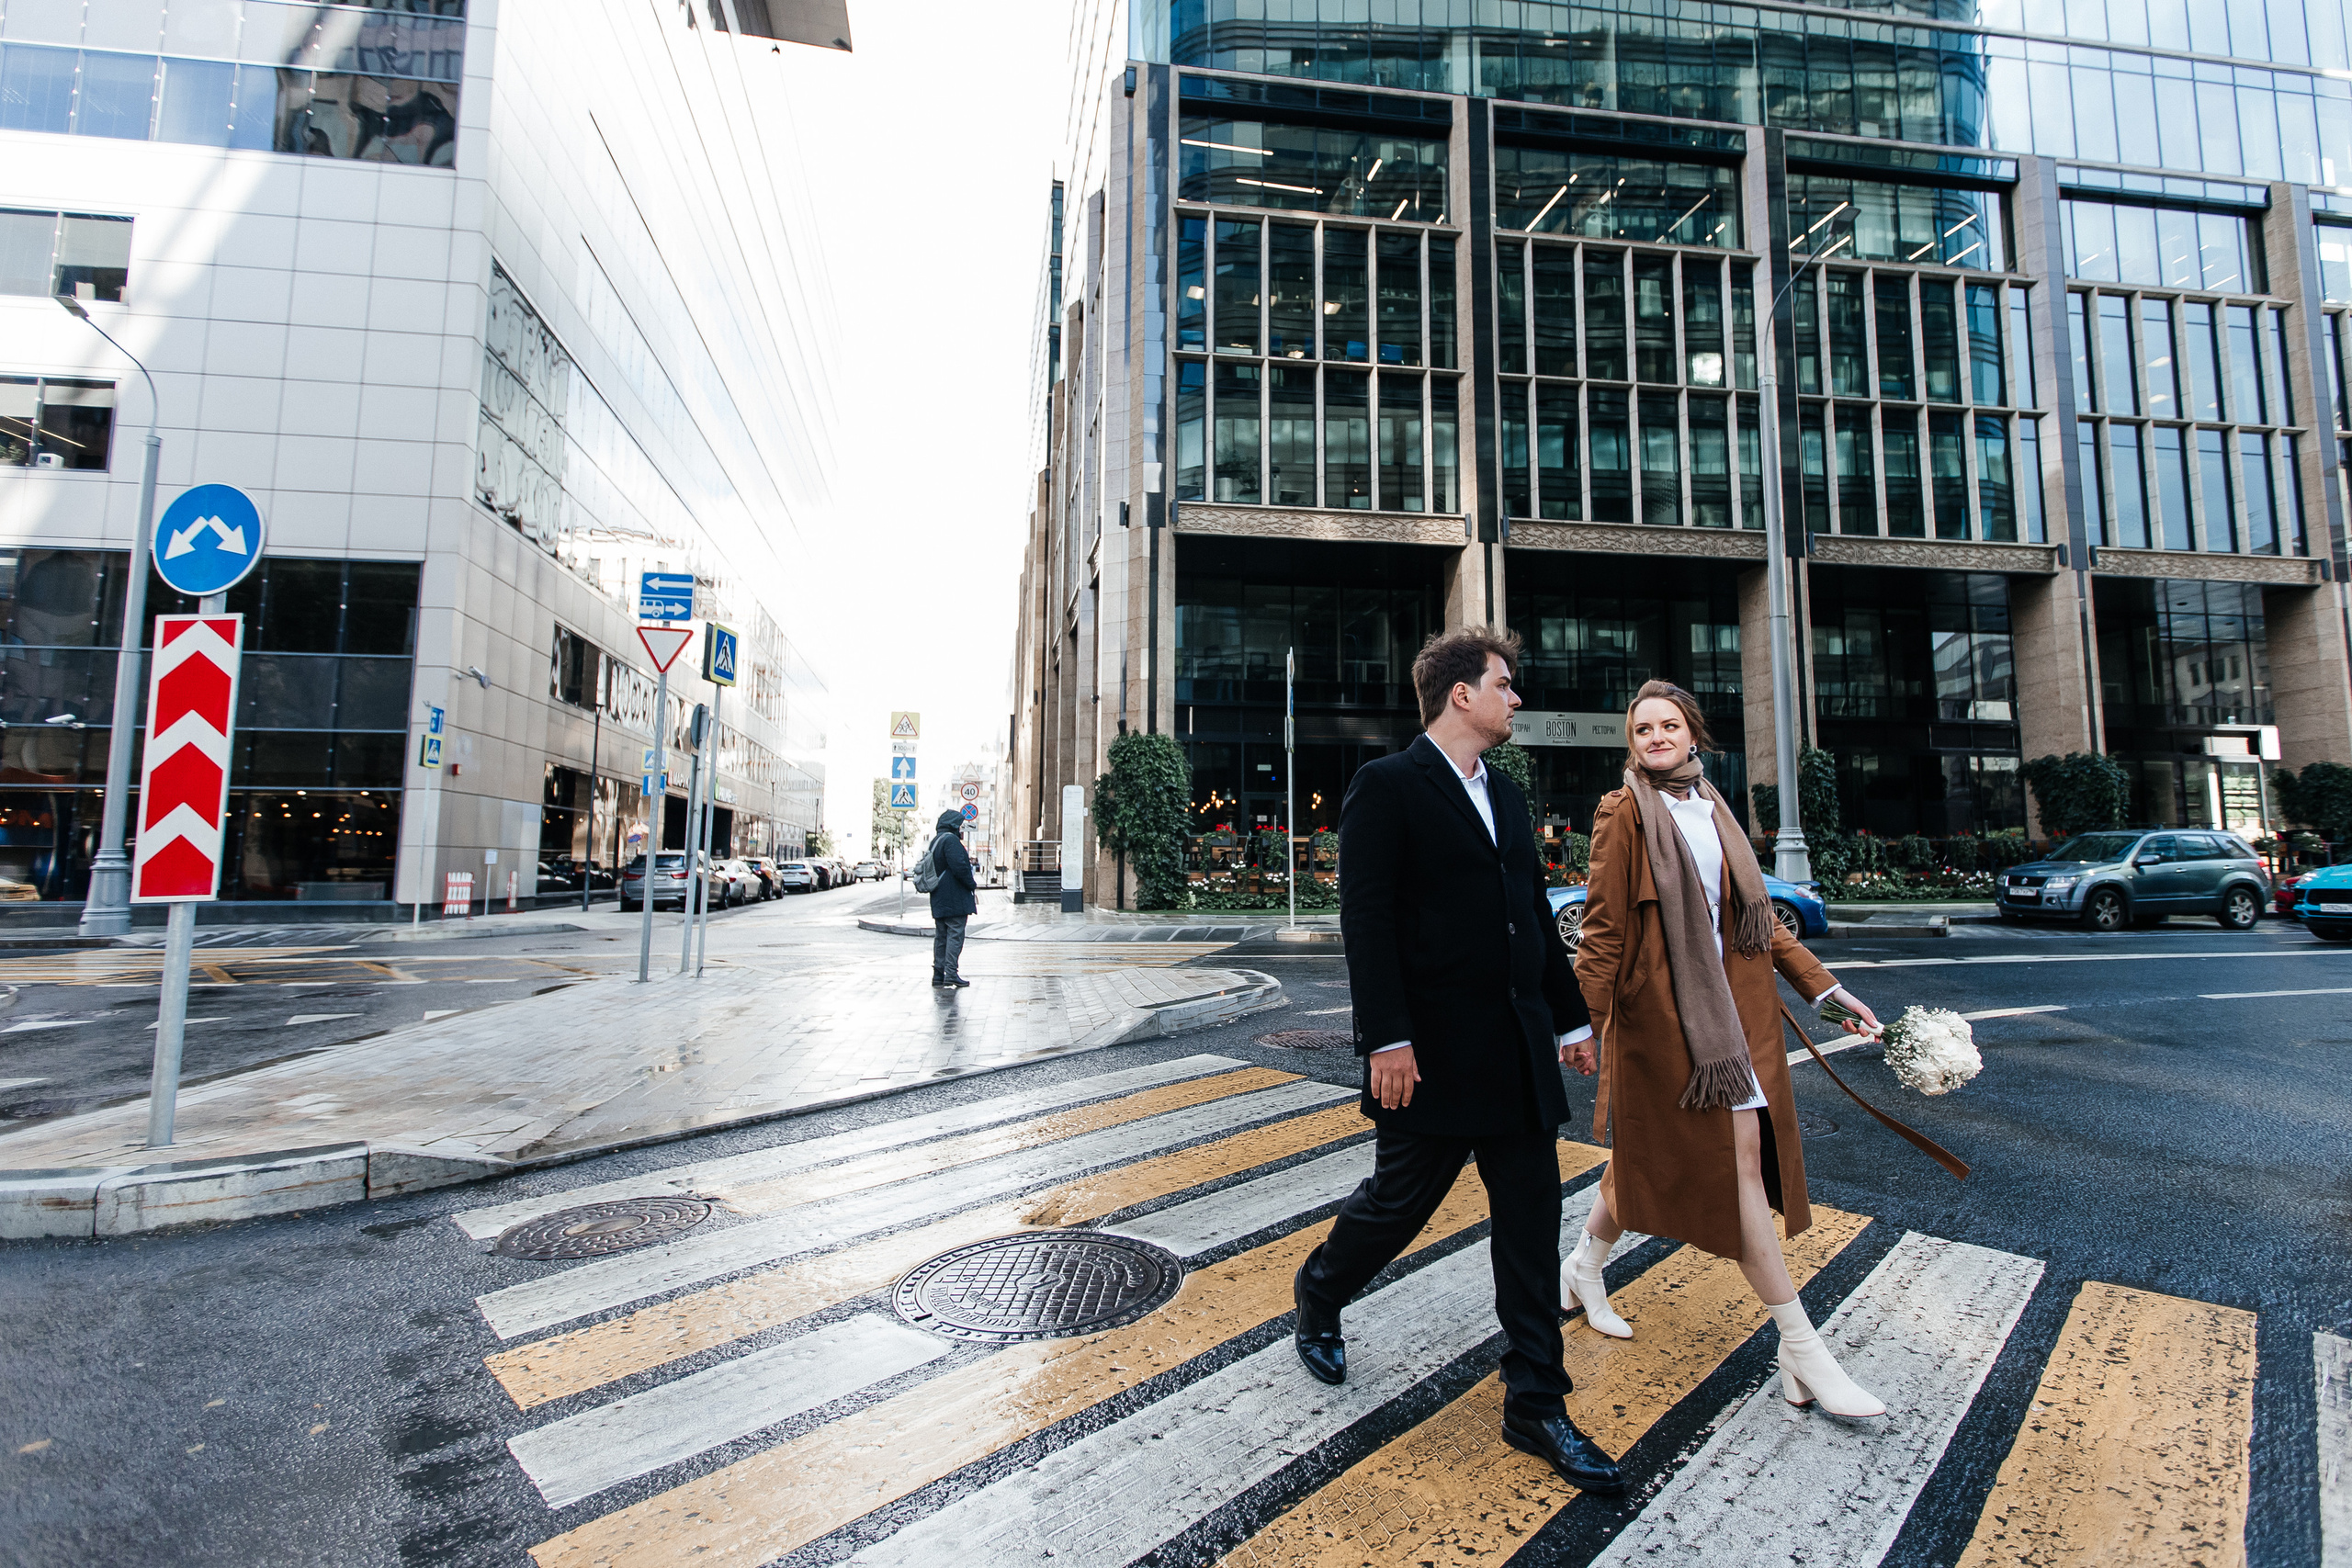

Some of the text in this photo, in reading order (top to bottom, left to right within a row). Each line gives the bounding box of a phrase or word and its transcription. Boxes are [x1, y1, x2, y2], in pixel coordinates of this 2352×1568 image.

[1511, 723, 1532, 733] СТОРАН
[1545, 720, 1577, 738] BOSTON
[1591, 725, 1617, 735] РЕСТОРАН
